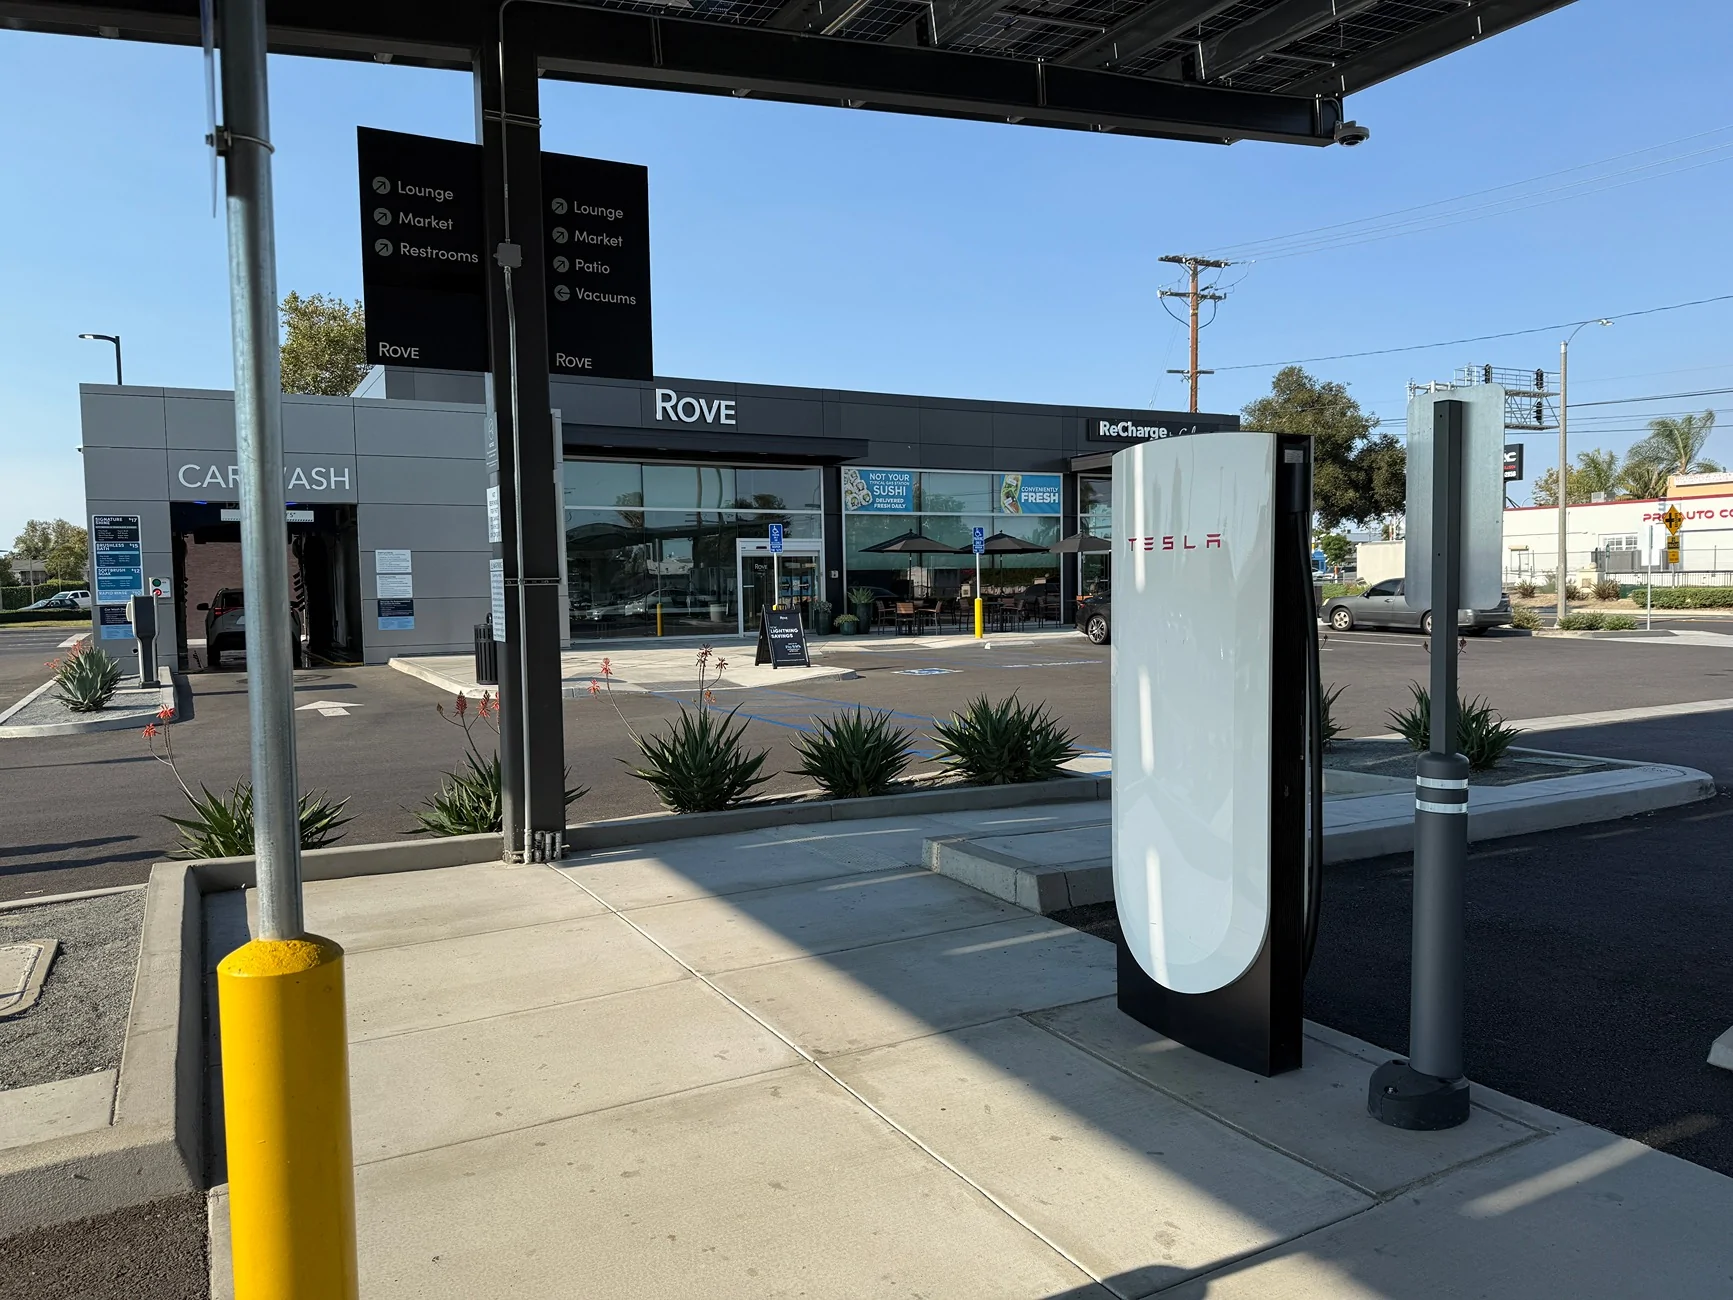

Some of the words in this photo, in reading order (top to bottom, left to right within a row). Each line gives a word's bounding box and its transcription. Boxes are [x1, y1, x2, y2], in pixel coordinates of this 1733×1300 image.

[398, 180, 454, 202] Lounge
[574, 200, 624, 221] Lounge
[399, 211, 453, 230] Market
[574, 230, 623, 247] Market
[400, 242, 479, 263] Restrooms
[576, 259, 610, 274] Patio
[576, 287, 636, 305] Vacuums
[378, 341, 420, 359] ROVE
[556, 352, 592, 369] ROVE
[655, 388, 736, 425] ROVE
[1099, 420, 1168, 440] ReCharge
[282, 467, 350, 489] ASH
[888, 473, 910, 481] YOUR
[873, 485, 906, 496] SUSHI
[1021, 492, 1059, 503] FRESH
[1128, 533, 1221, 552] TESLA
